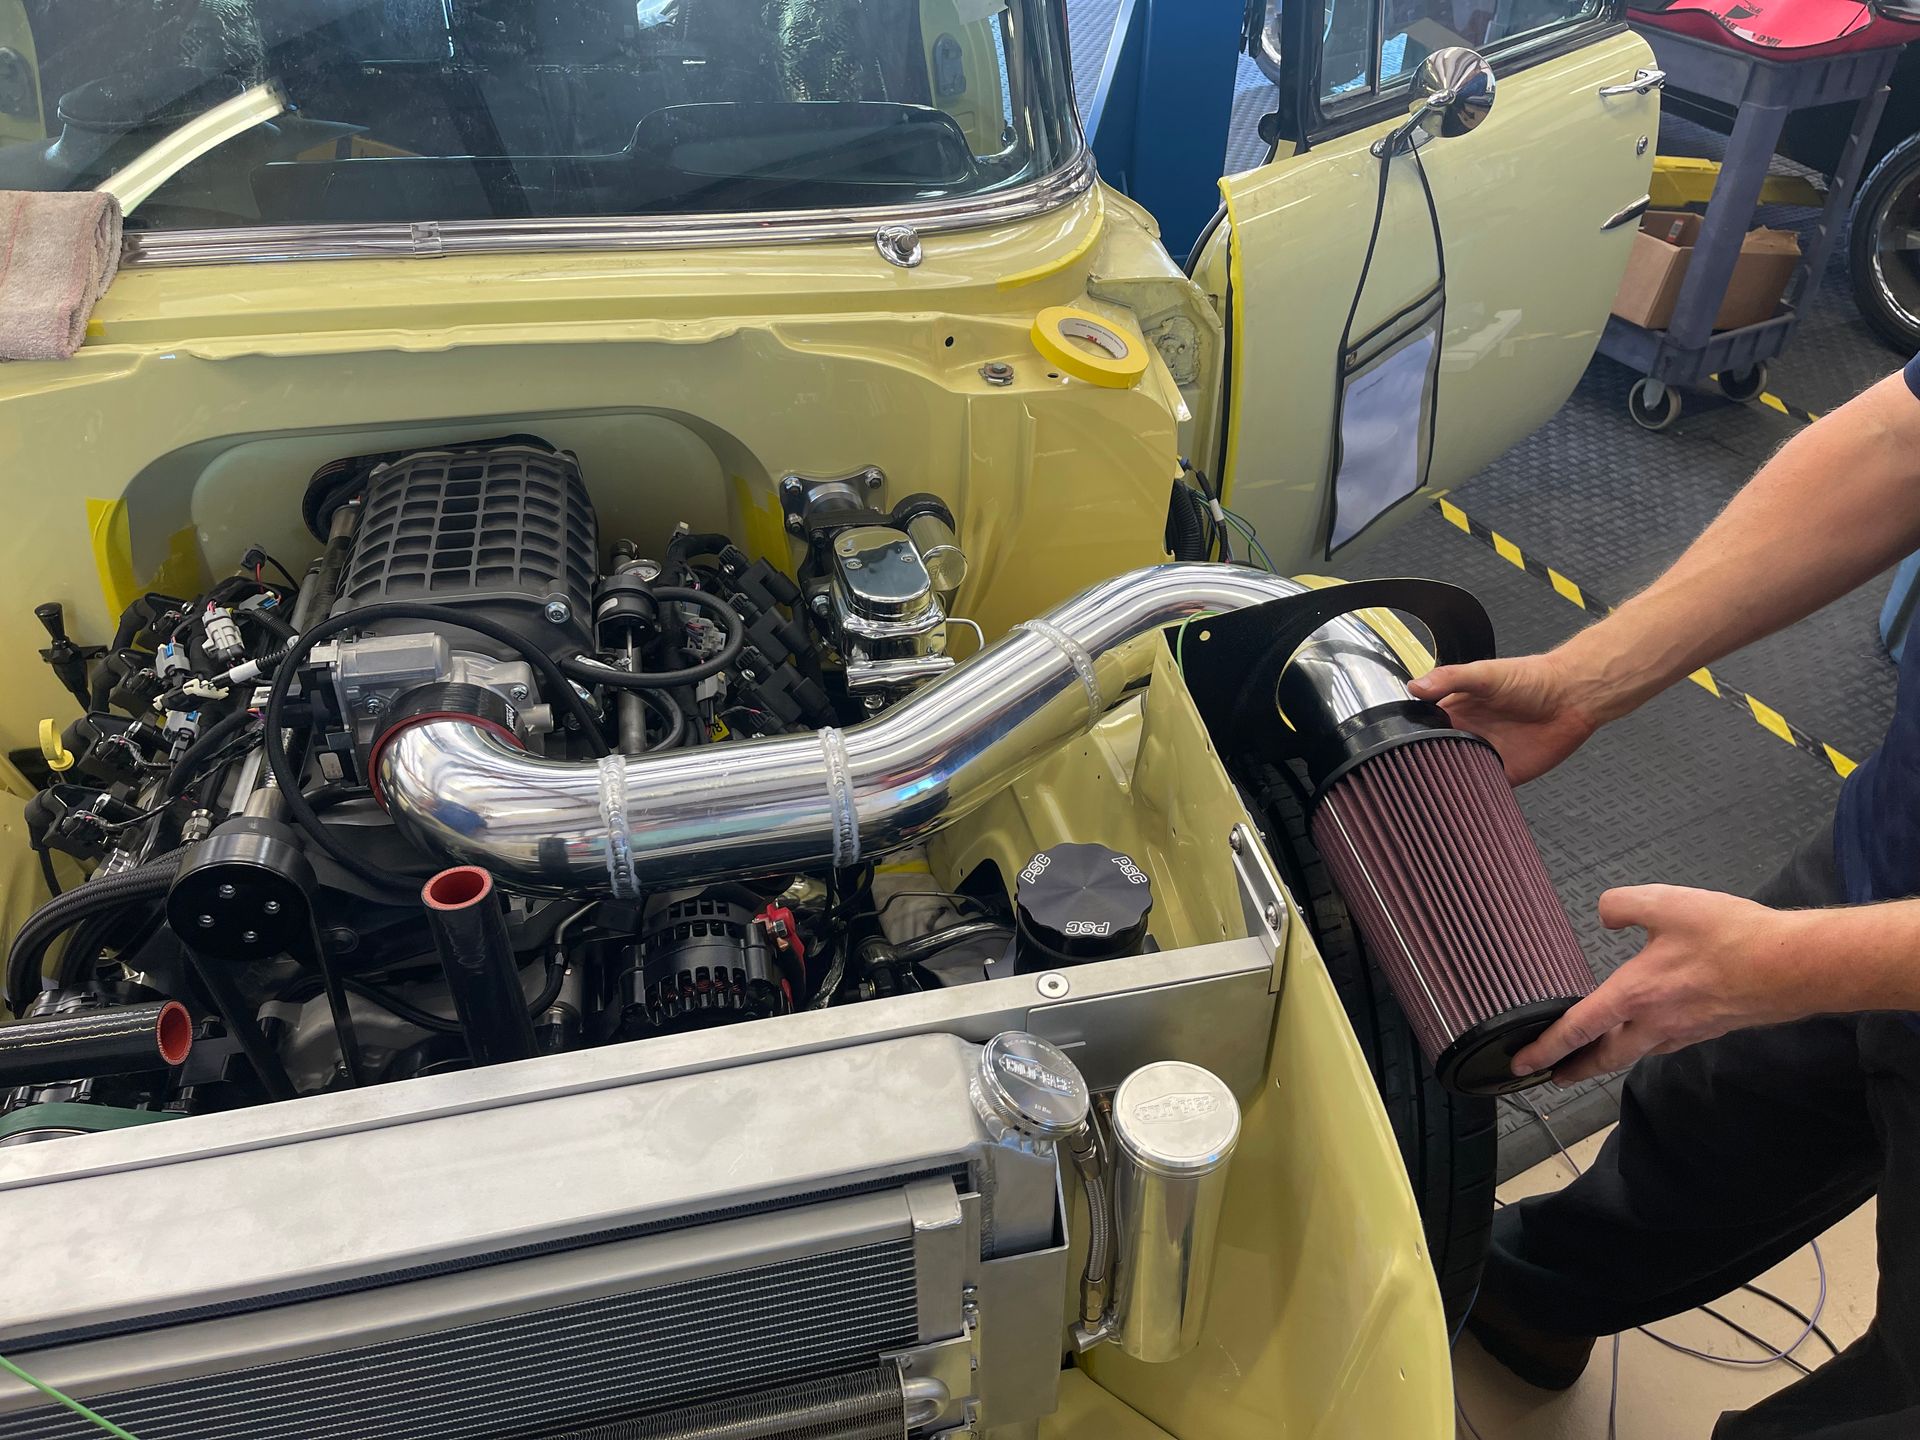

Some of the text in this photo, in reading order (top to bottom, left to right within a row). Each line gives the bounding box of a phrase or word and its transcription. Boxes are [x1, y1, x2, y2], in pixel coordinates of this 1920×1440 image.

[1020, 853, 1051, 884] PSC
[1111, 855, 1148, 884] PSC
[1065, 920, 1110, 936] PSC
